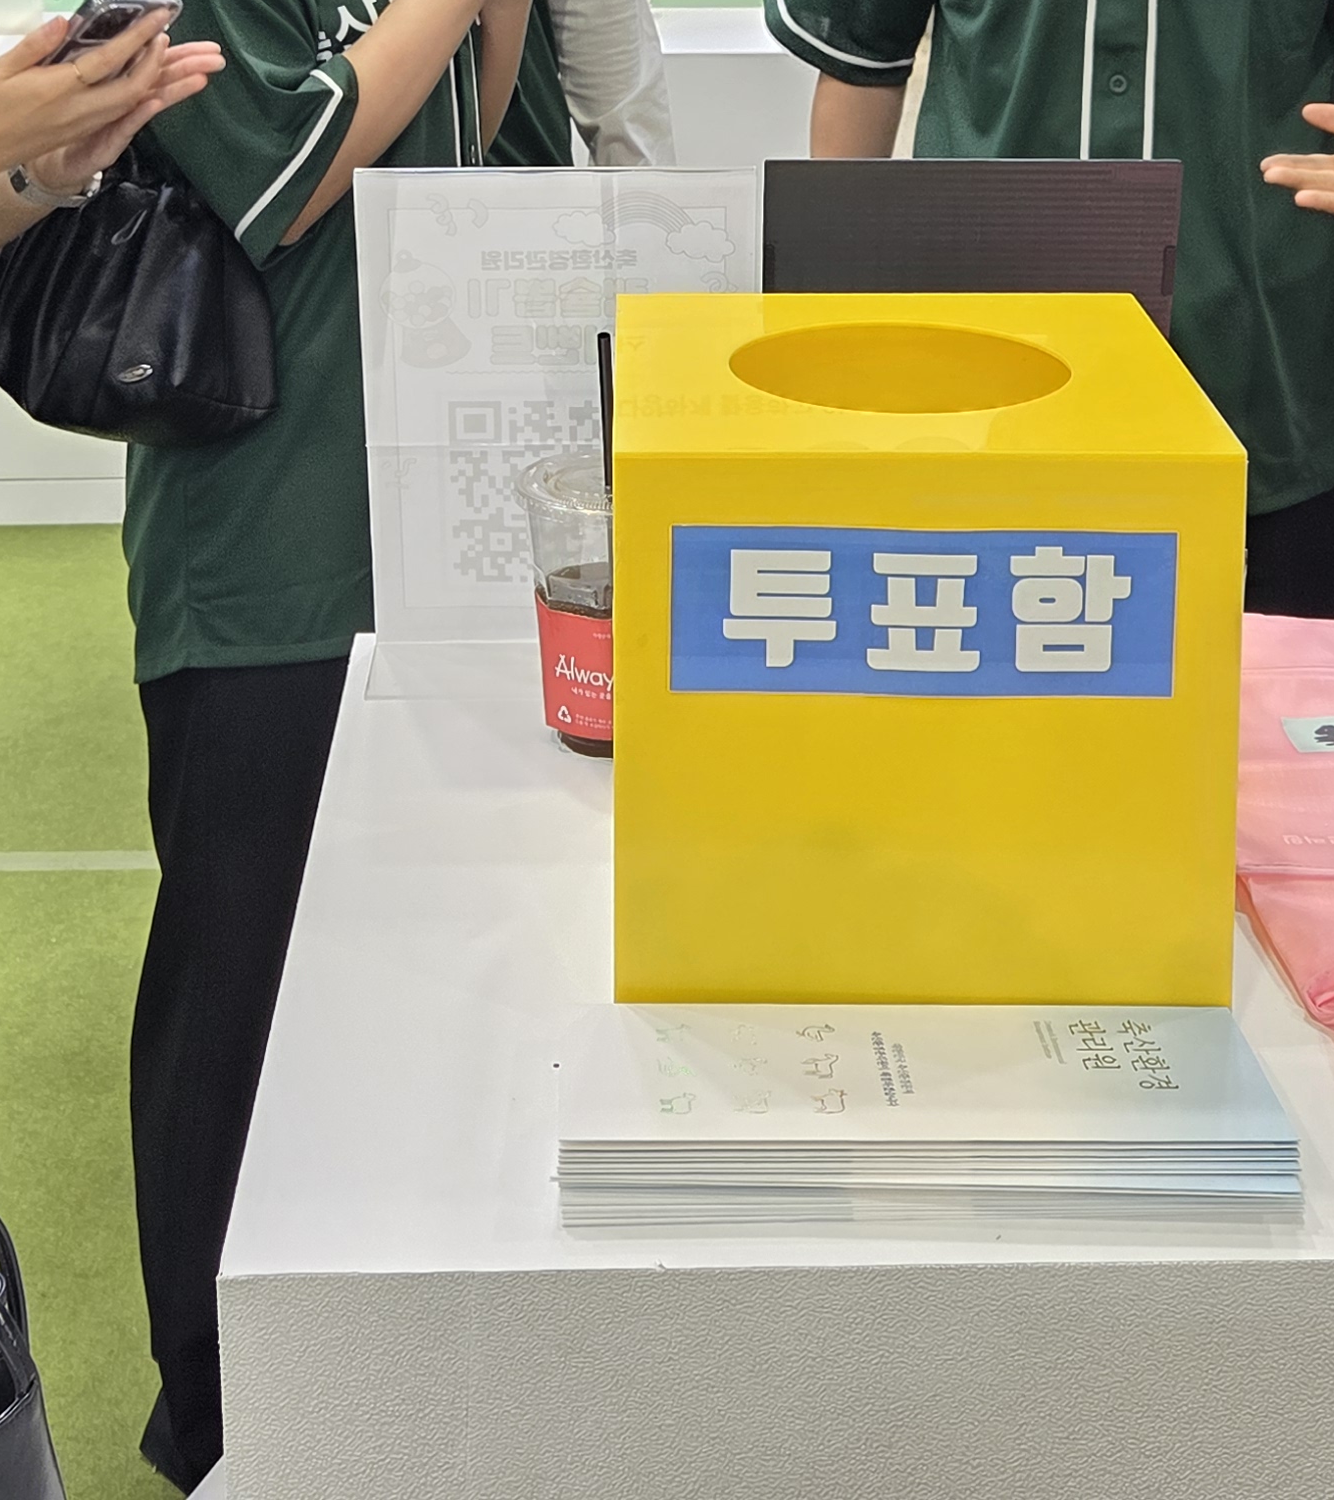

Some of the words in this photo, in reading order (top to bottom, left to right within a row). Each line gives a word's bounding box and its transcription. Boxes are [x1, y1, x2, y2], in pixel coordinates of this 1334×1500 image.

[722, 546, 1131, 672] 투표함
[1068, 1019, 1121, 1071] 관리원
[1117, 1019, 1179, 1090] 축산환경
